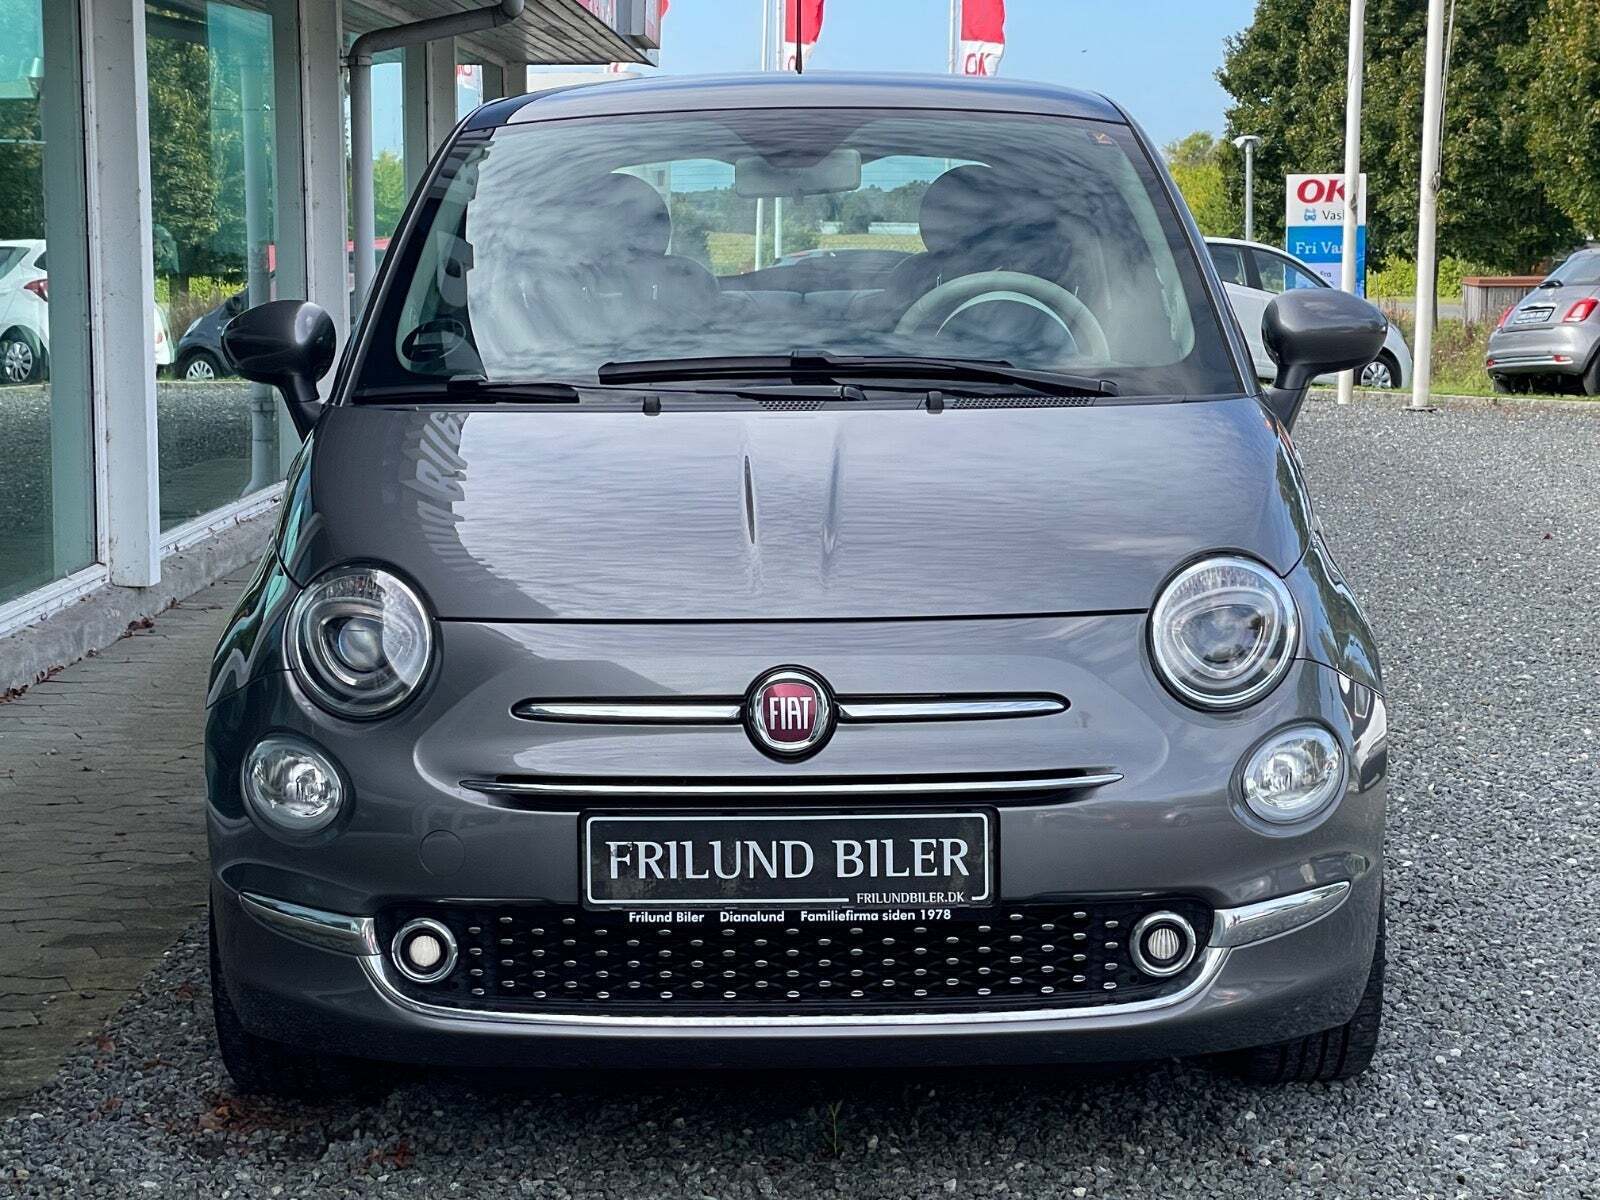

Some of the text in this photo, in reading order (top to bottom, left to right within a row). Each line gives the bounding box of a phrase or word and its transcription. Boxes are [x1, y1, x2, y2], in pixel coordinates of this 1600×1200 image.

[1297, 179, 1345, 203] OK
[1296, 242, 1316, 254] Fri
[769, 697, 812, 730] FIAT
[605, 838, 969, 879] FRILUND BILER
[856, 891, 965, 904] FRILUNDBILER.DK
[629, 908, 951, 923] Frilund Biler Dianalund Familiefirma siden 1978
